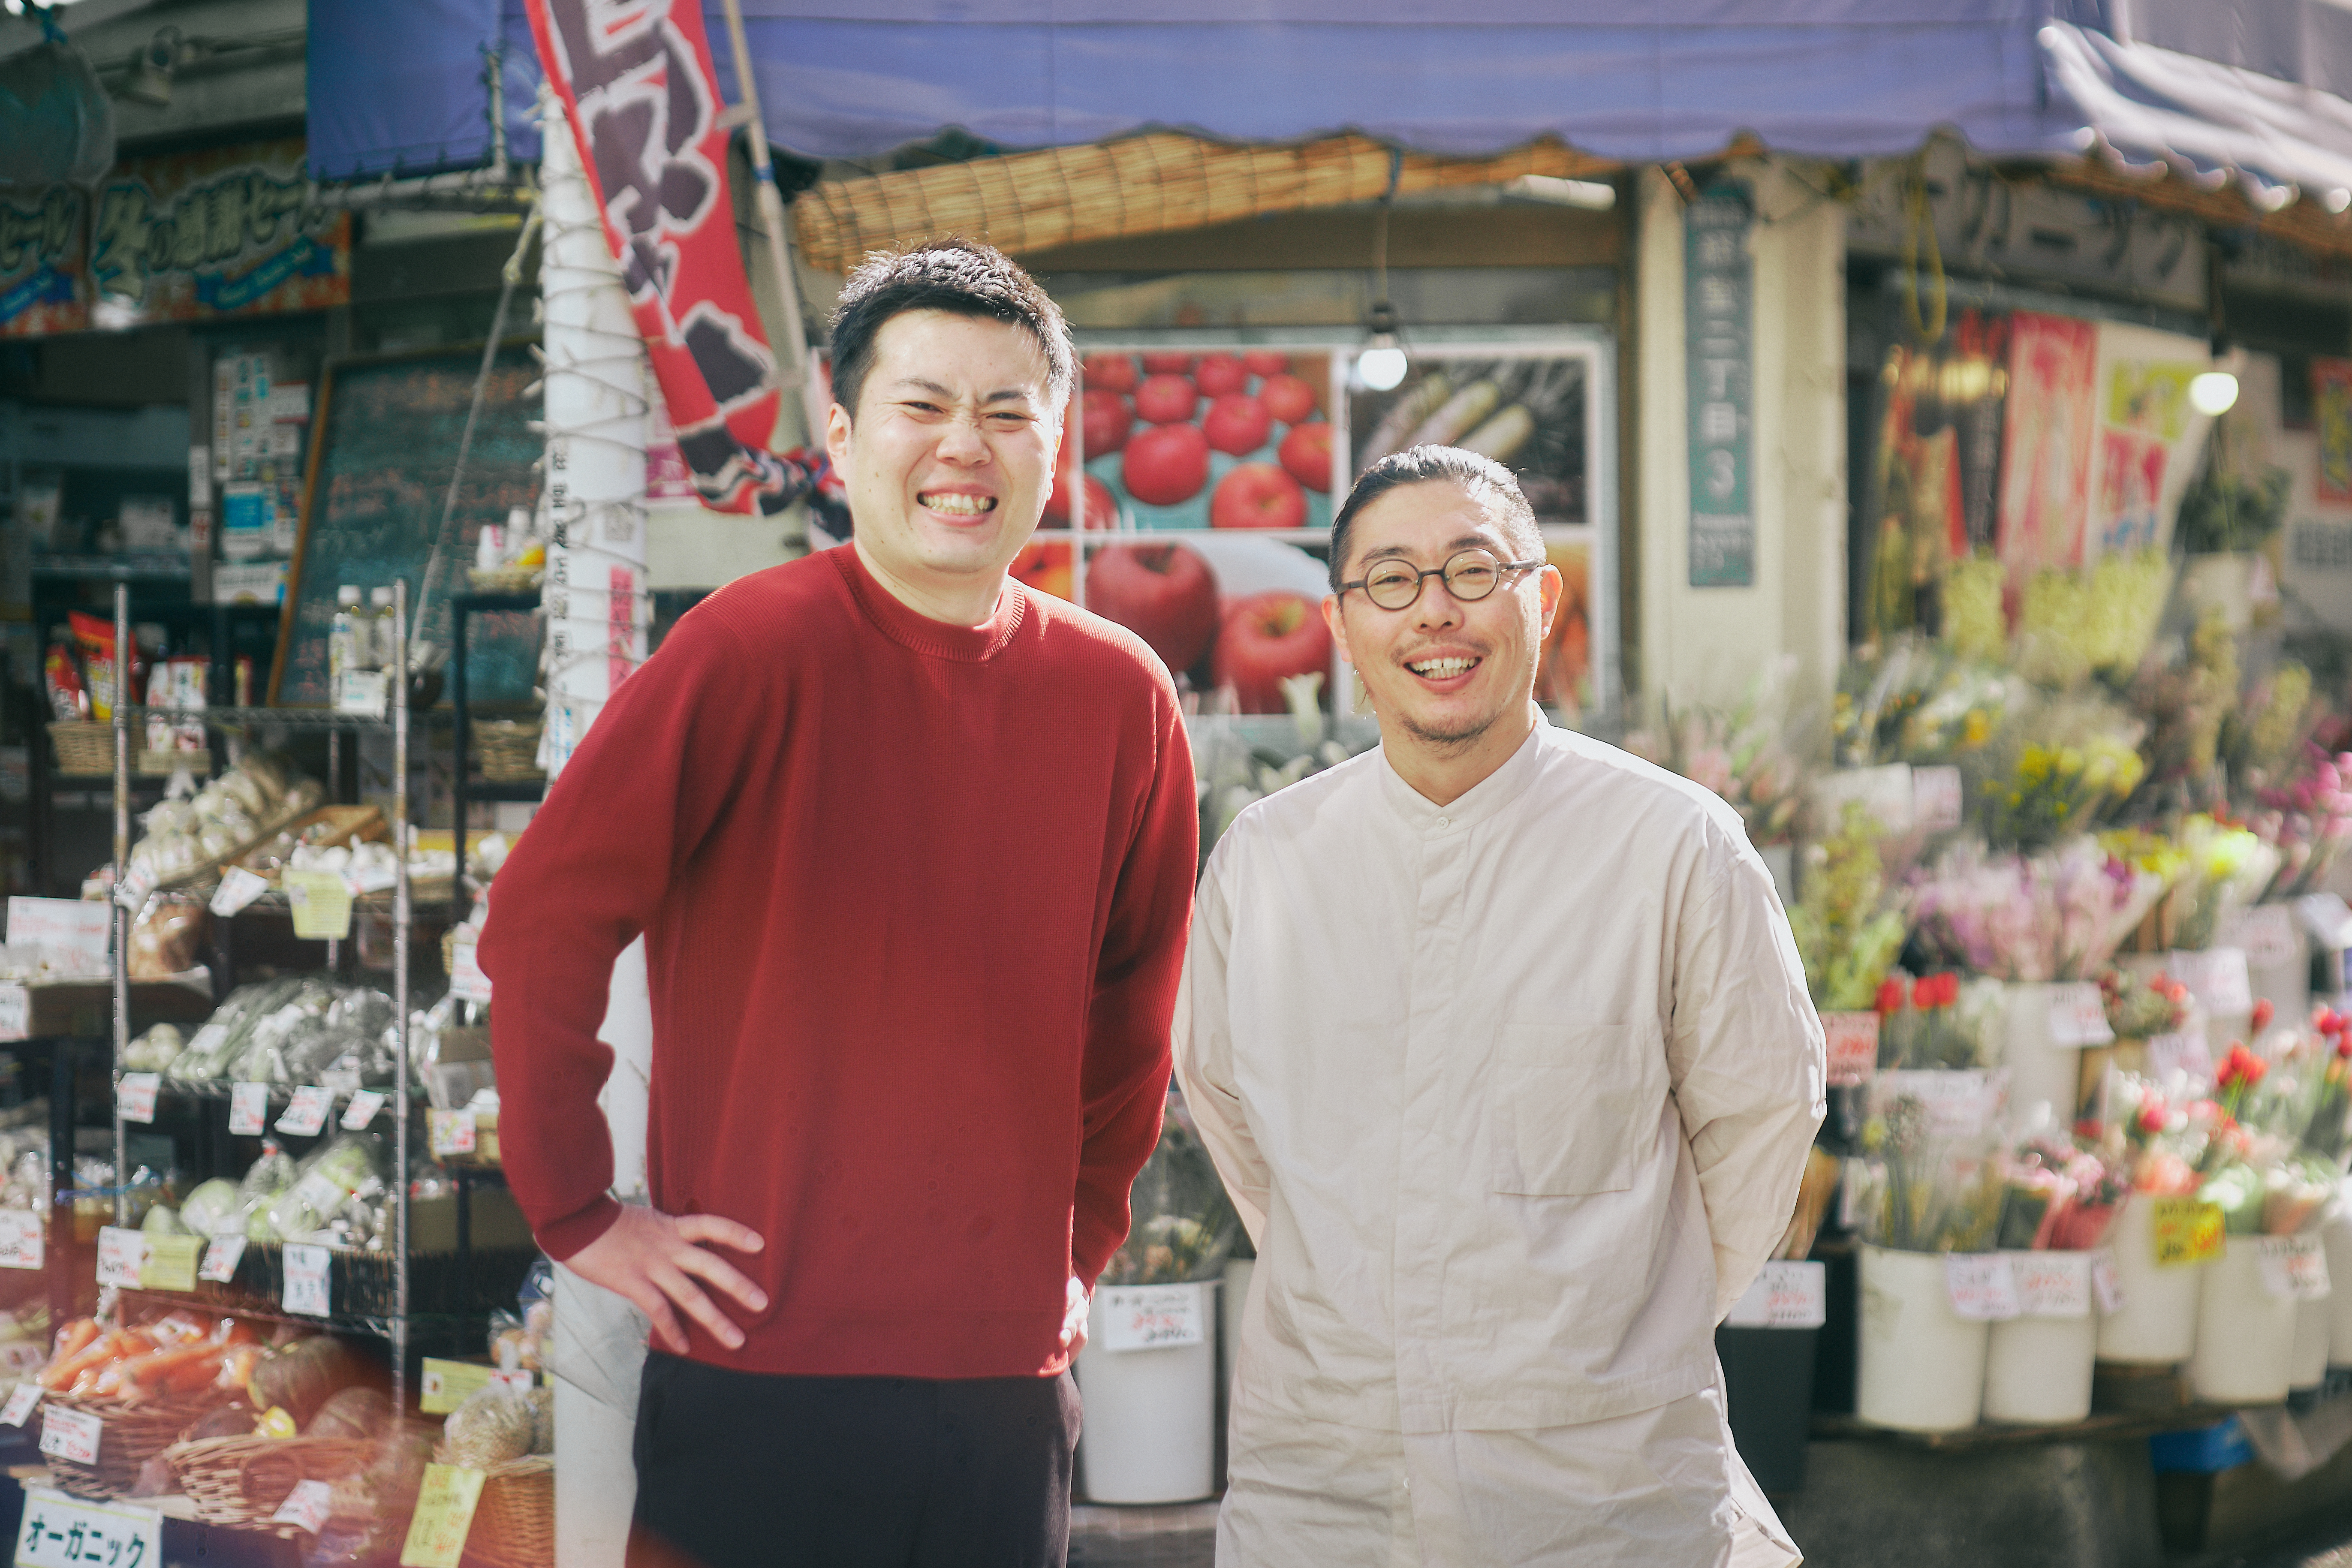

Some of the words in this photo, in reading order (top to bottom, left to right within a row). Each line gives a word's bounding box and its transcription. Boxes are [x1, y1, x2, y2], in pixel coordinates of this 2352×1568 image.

[26, 1513, 145, 1568] オーガニック
